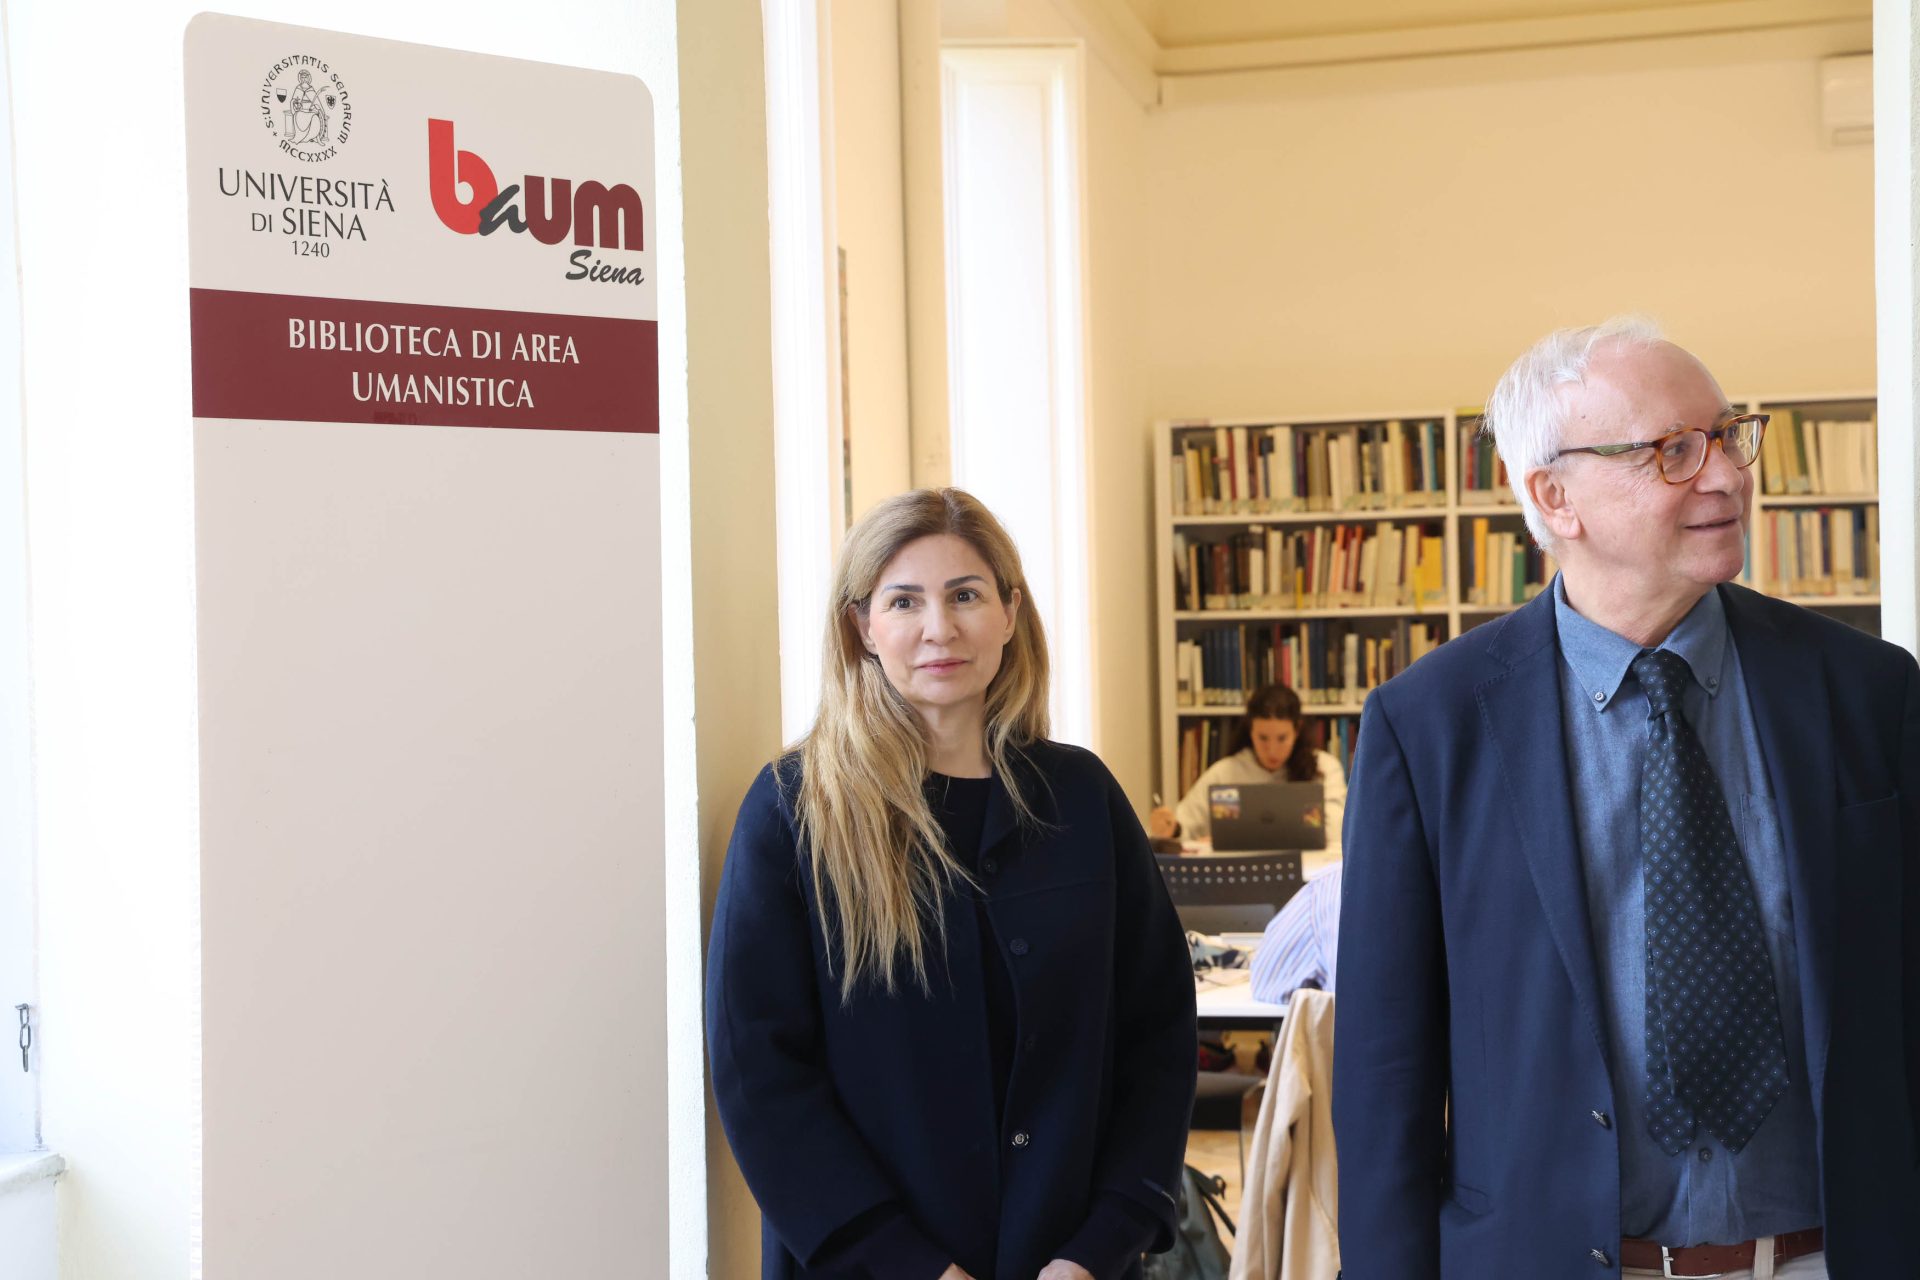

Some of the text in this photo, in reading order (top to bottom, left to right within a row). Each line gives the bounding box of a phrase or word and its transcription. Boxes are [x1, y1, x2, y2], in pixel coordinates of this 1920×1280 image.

[218, 167, 396, 213] UNIVERSITÀ
[251, 207, 367, 242] DI SIENA
[292, 240, 330, 258] 1240
[565, 249, 645, 286] Siena
[288, 317, 580, 364] BIBLIOTECA DI AREA
[351, 371, 535, 409] UMANISTICA
